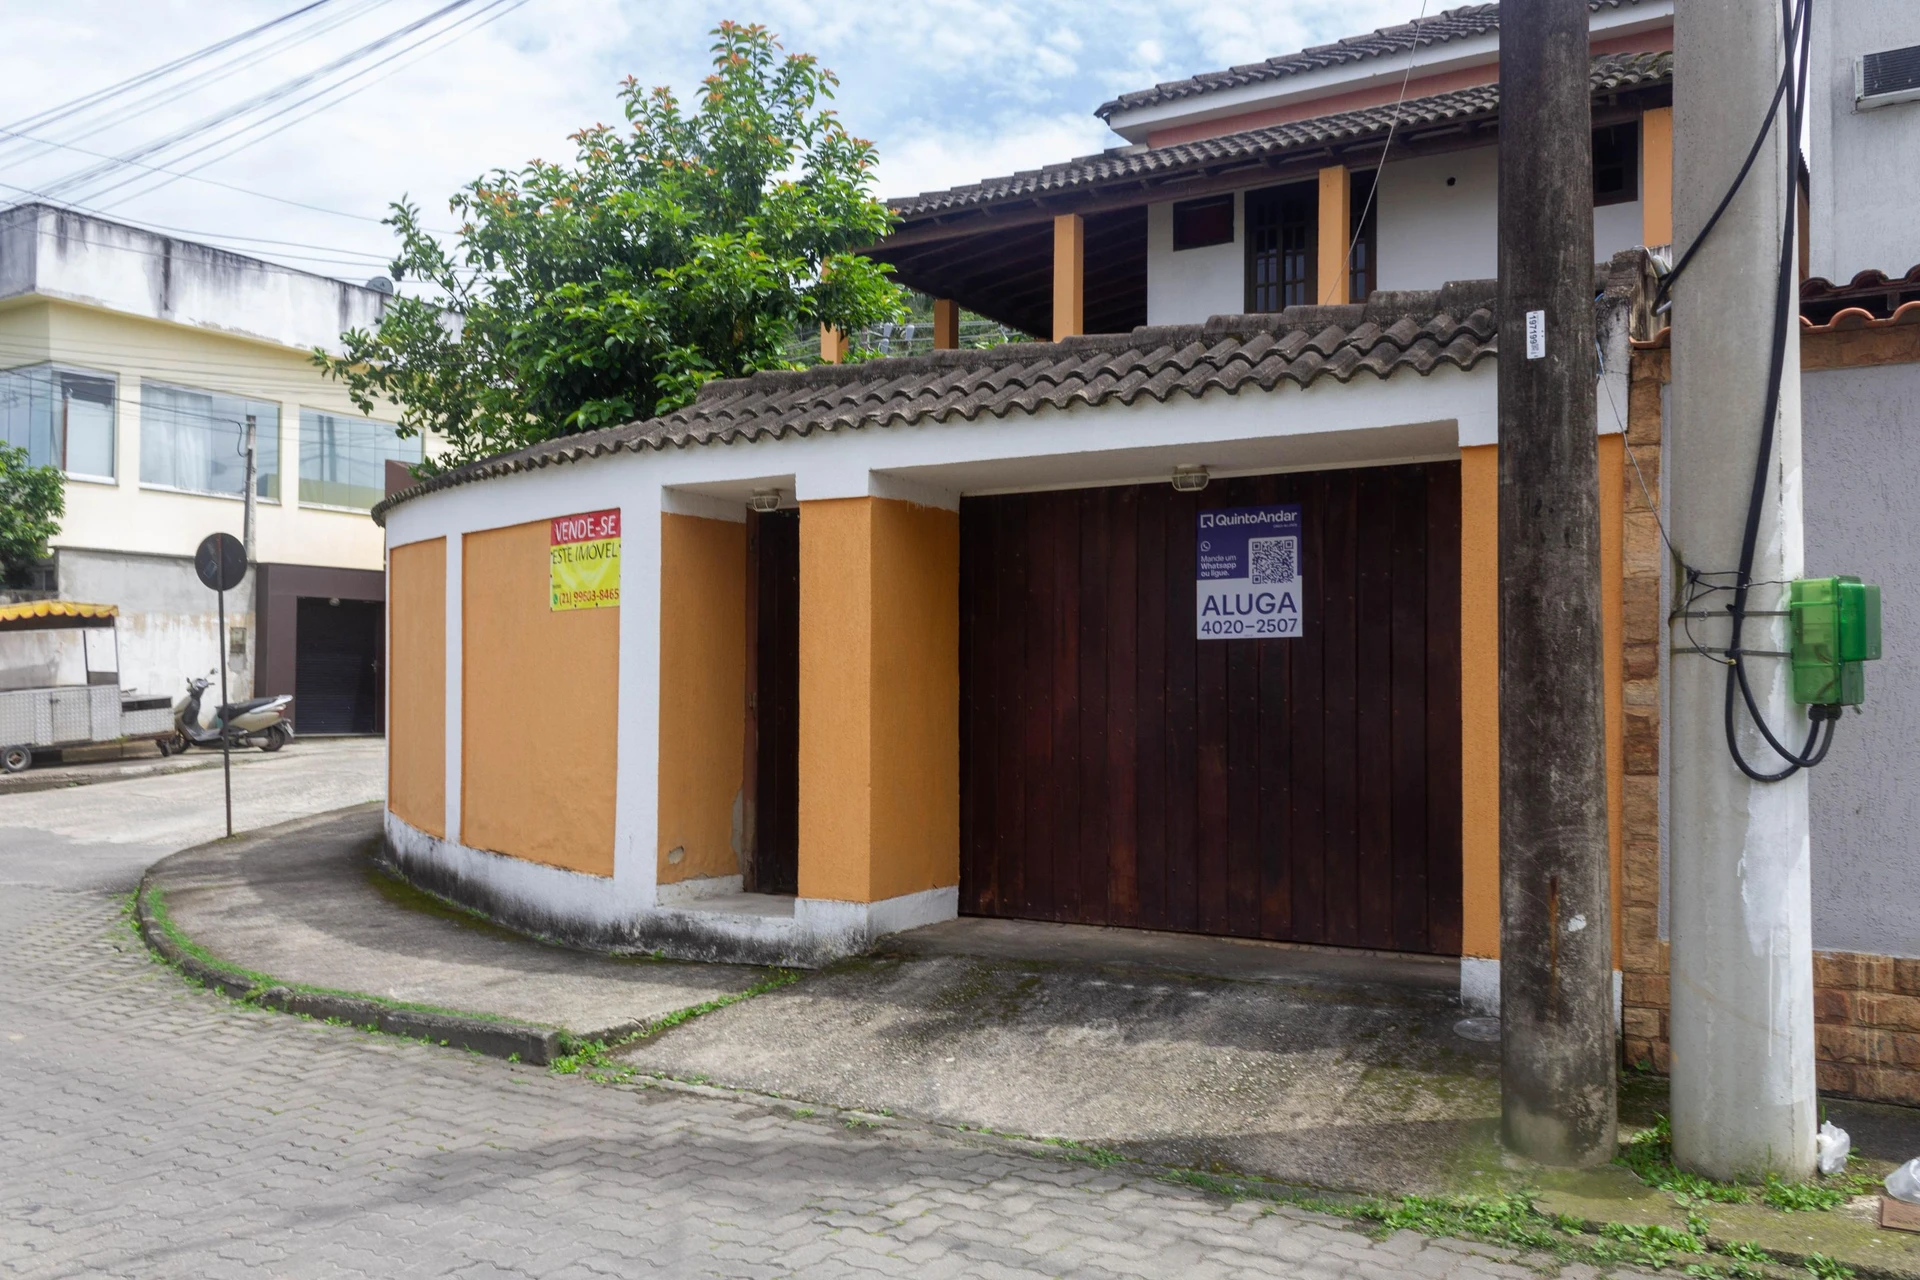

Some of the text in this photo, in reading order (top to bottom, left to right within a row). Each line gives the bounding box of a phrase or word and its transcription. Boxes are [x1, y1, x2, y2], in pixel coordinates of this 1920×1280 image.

[1529, 315, 1537, 344] 197199
[1216, 511, 1297, 525] QuintoAndar
[555, 515, 616, 542] VENDE-SE
[552, 547, 573, 564] ESTE
[1200, 562, 1237, 570] Whatsapp
[1211, 569, 1230, 578] ligue.
[1202, 592, 1297, 616] ALUGA
[1201, 618, 1298, 634] 4020-2507
